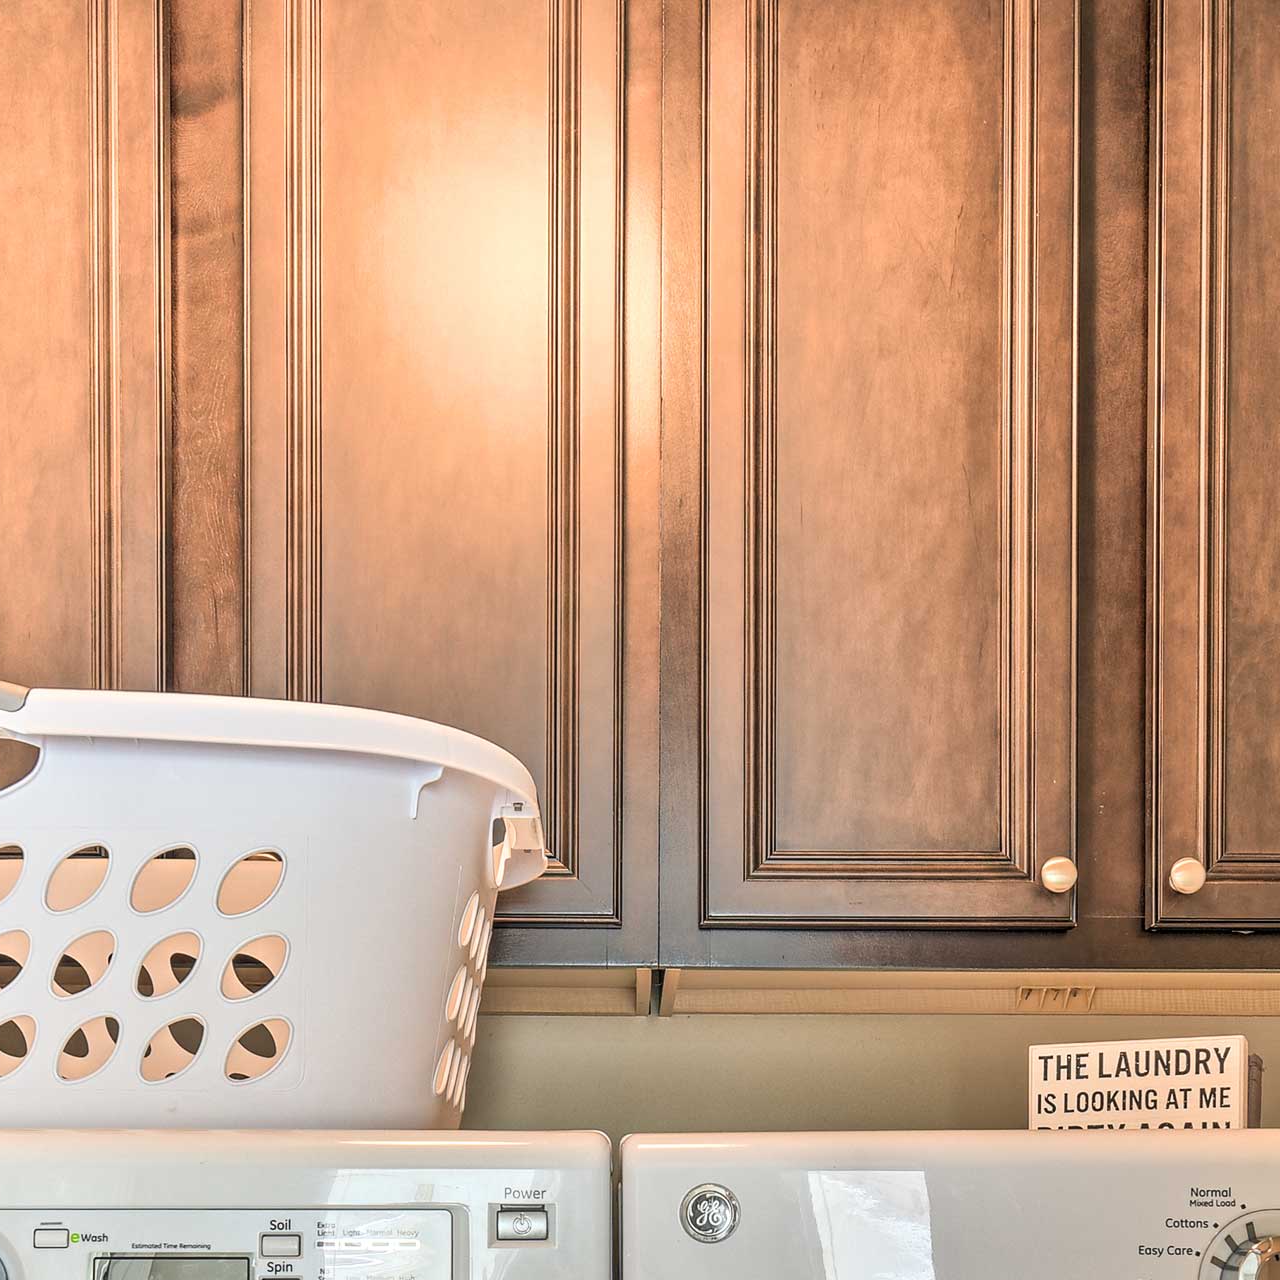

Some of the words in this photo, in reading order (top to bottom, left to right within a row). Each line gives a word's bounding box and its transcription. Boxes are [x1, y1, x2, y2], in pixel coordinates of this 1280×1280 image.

[1038, 1052, 1089, 1081] THE
[1098, 1047, 1231, 1080] LAUNDRY
[1037, 1093, 1057, 1115] IS
[1063, 1088, 1158, 1114] LOOKING
[1165, 1088, 1192, 1110] AT
[1199, 1087, 1231, 1109] ME
[504, 1187, 547, 1200] Power
[1190, 1187, 1232, 1198] Normal
[1189, 1199, 1214, 1207] Mixed
[1216, 1199, 1236, 1207] Load
[269, 1219, 292, 1231] Soil
[1165, 1218, 1209, 1229] Cottons
[179, 1243, 211, 1251] Remaining
[1138, 1245, 1164, 1257] Easy
[1166, 1245, 1193, 1256] Care
[267, 1261, 293, 1274] Spin
